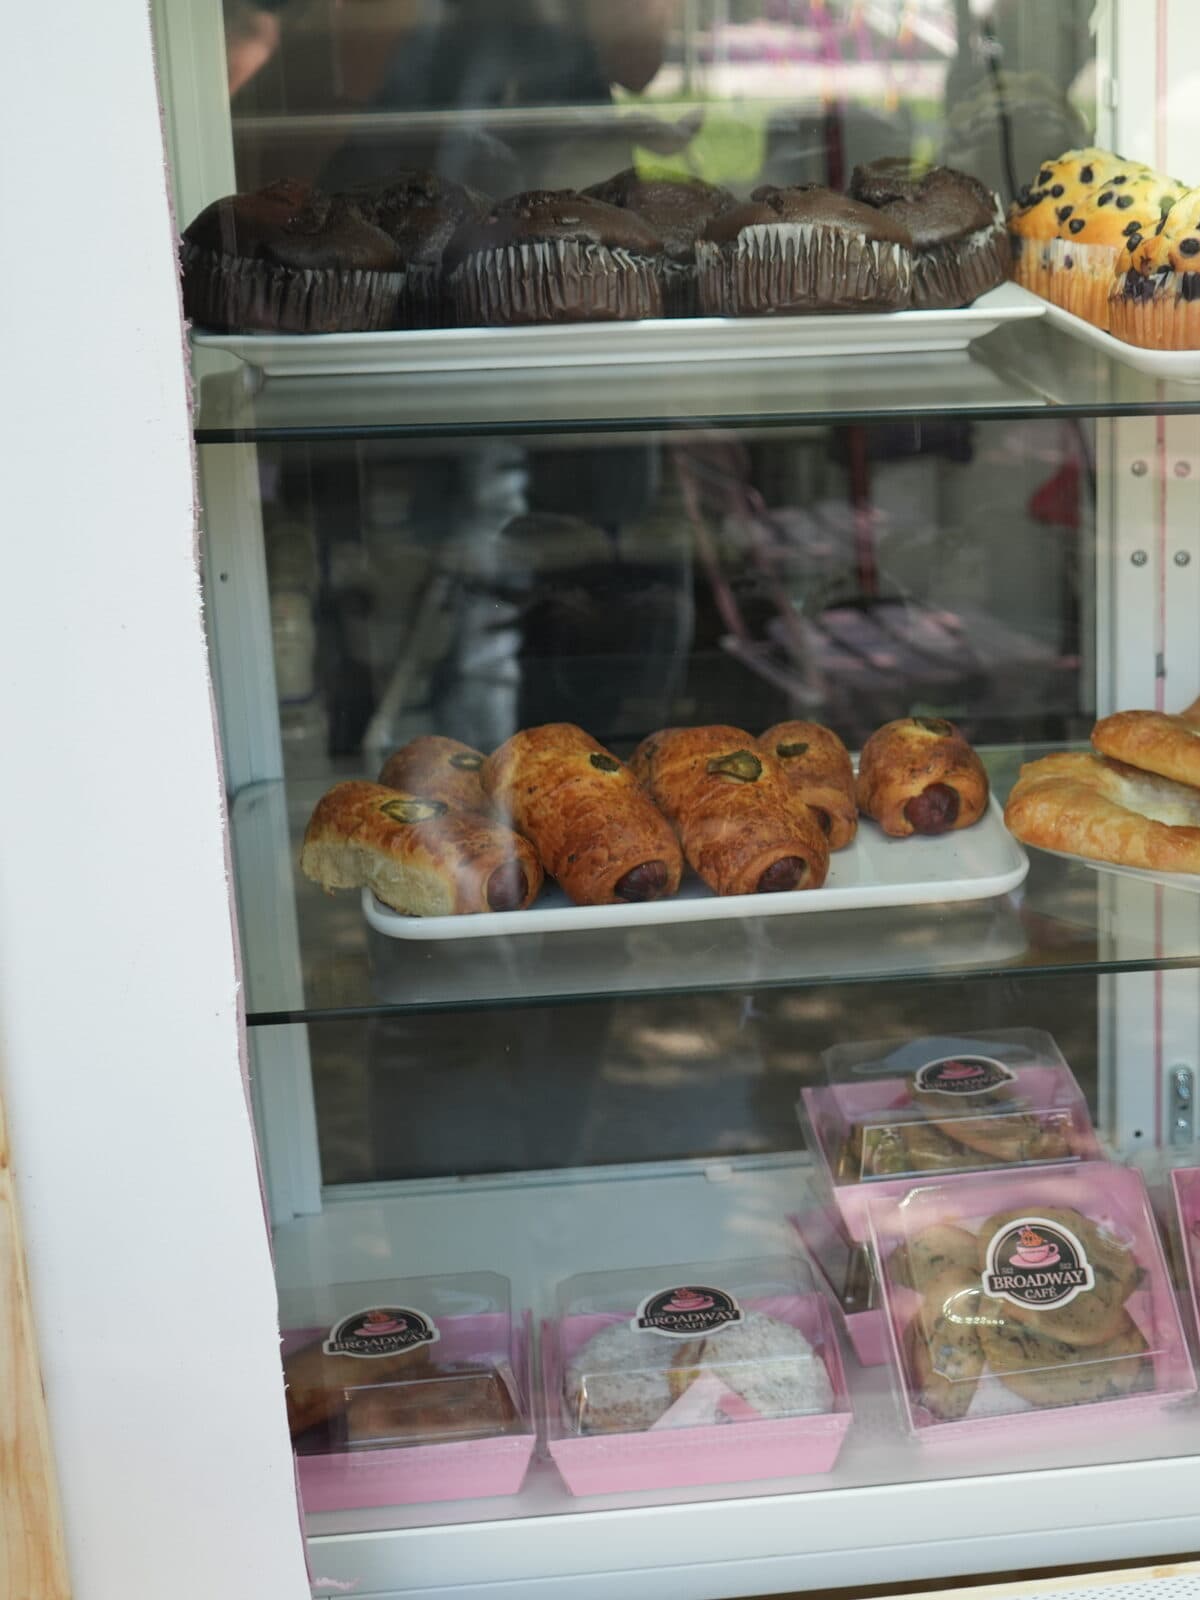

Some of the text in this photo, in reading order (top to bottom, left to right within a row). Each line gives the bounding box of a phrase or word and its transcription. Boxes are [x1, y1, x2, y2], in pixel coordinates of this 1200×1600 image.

[992, 1270, 1083, 1289] BROADWAY
[643, 1309, 735, 1326] BROADWAY
[333, 1332, 428, 1351] BROADWAY
